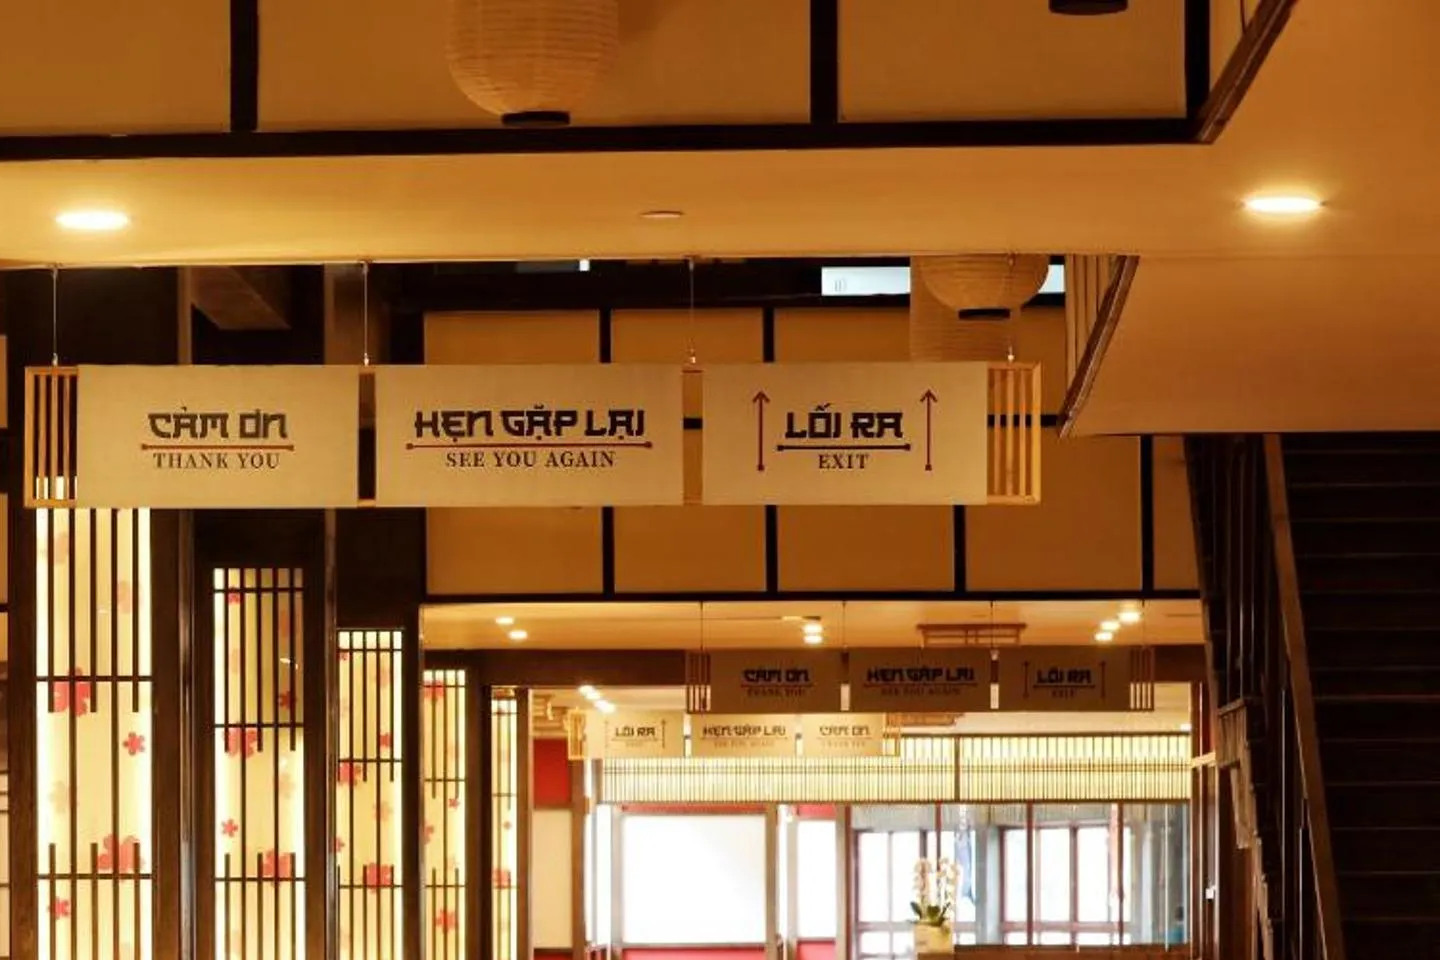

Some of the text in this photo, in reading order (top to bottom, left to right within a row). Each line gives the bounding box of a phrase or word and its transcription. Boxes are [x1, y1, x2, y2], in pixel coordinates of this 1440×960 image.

[414, 404, 645, 442] HẸN GẶP LẠI
[785, 403, 903, 438] LỐI RA
[153, 453, 280, 469] THANK YOU
[446, 451, 615, 467] SEE YOU AGAIN
[819, 454, 869, 469] EXIT
